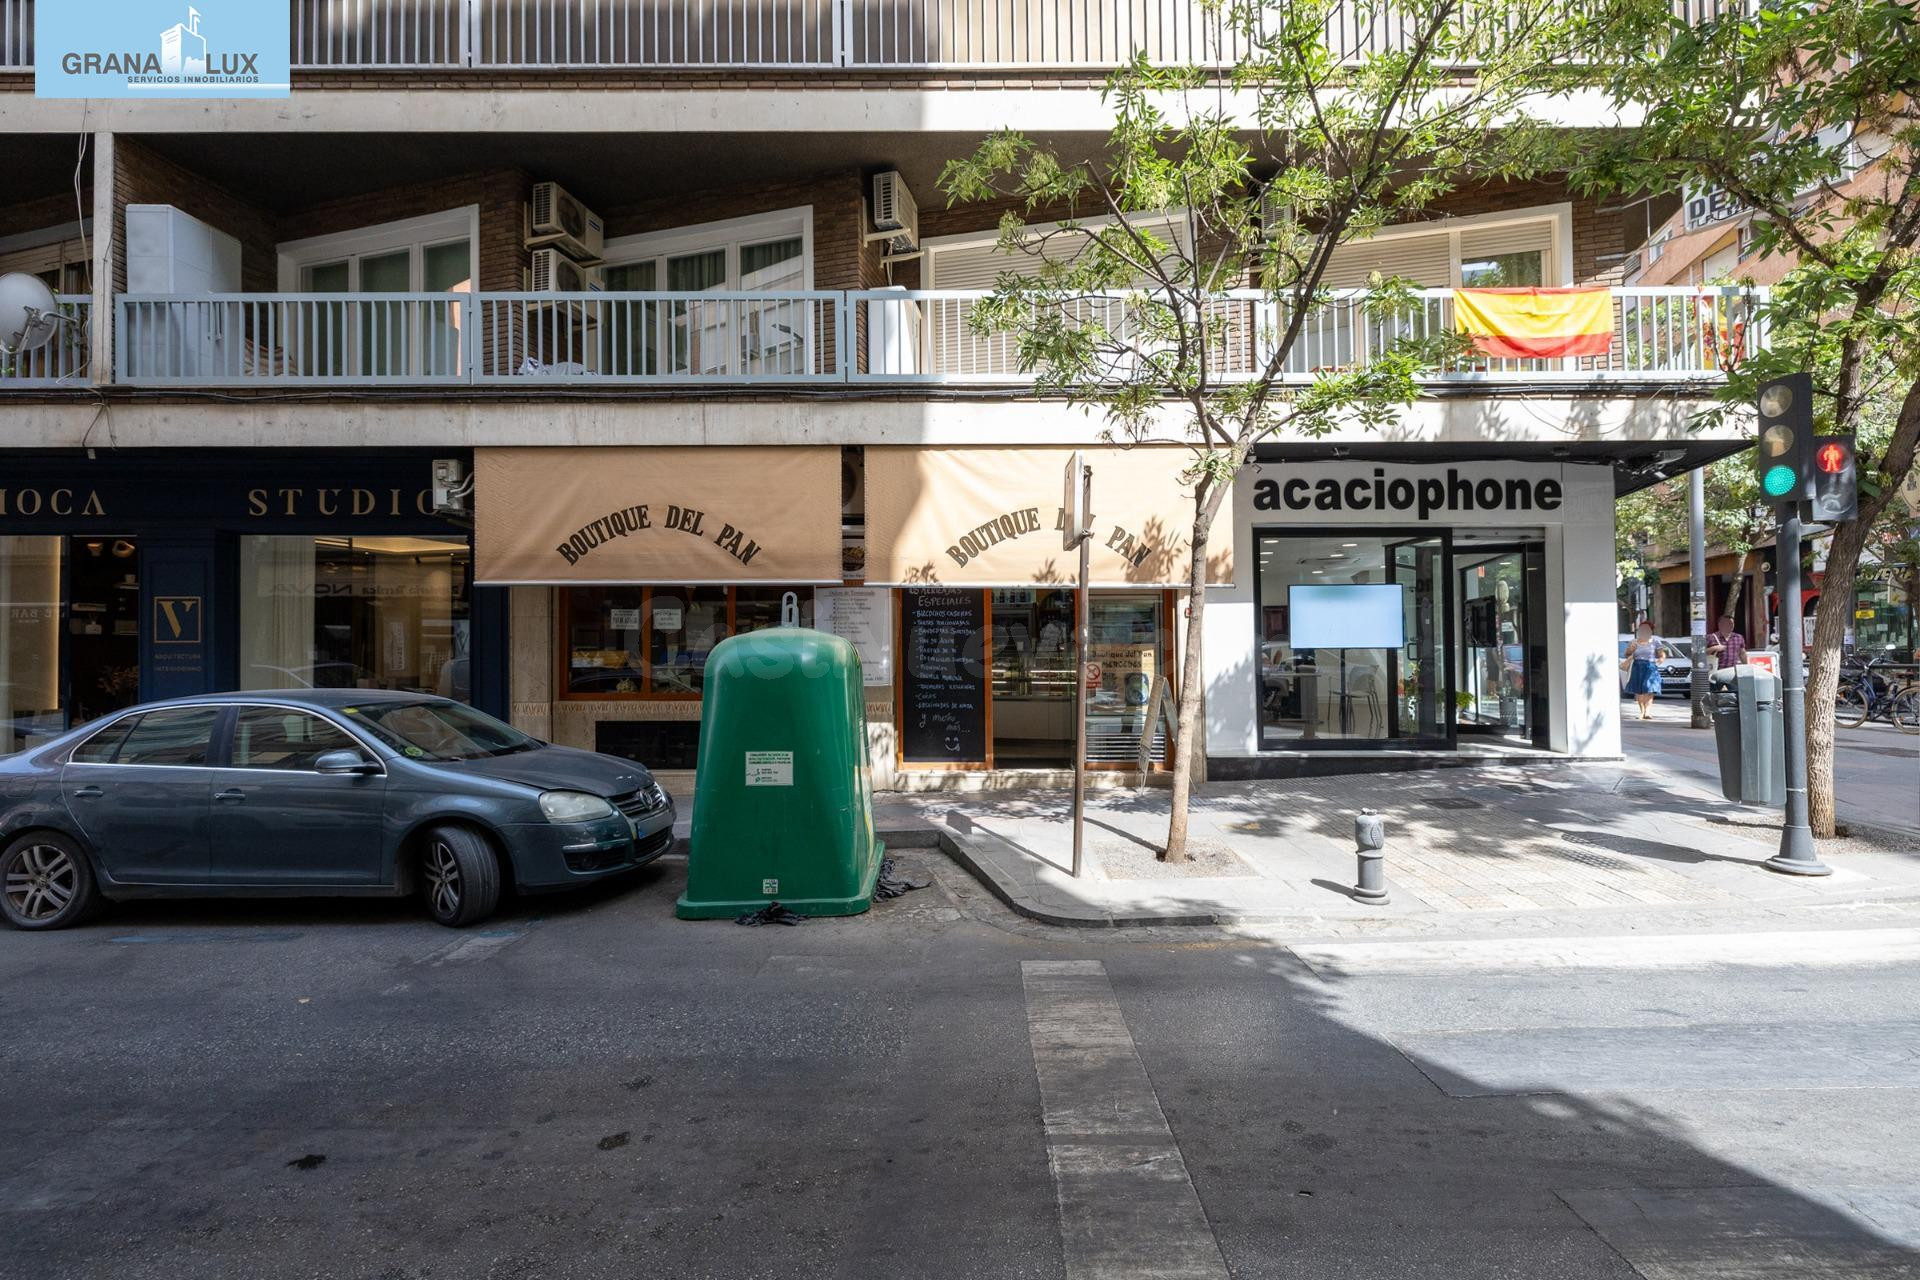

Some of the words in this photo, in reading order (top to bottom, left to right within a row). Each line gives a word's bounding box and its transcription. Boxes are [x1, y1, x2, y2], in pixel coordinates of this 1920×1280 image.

[248, 488, 440, 517] STUDIO
[1254, 468, 1562, 520] acaciophone
[556, 504, 652, 566] BOUTIQUE
[664, 505, 705, 536] DEL
[713, 523, 763, 566] PAN
[945, 507, 1042, 568] BOUTIQUE
[1104, 525, 1153, 568] PAN
[918, 595, 972, 607] ESPECIALES
